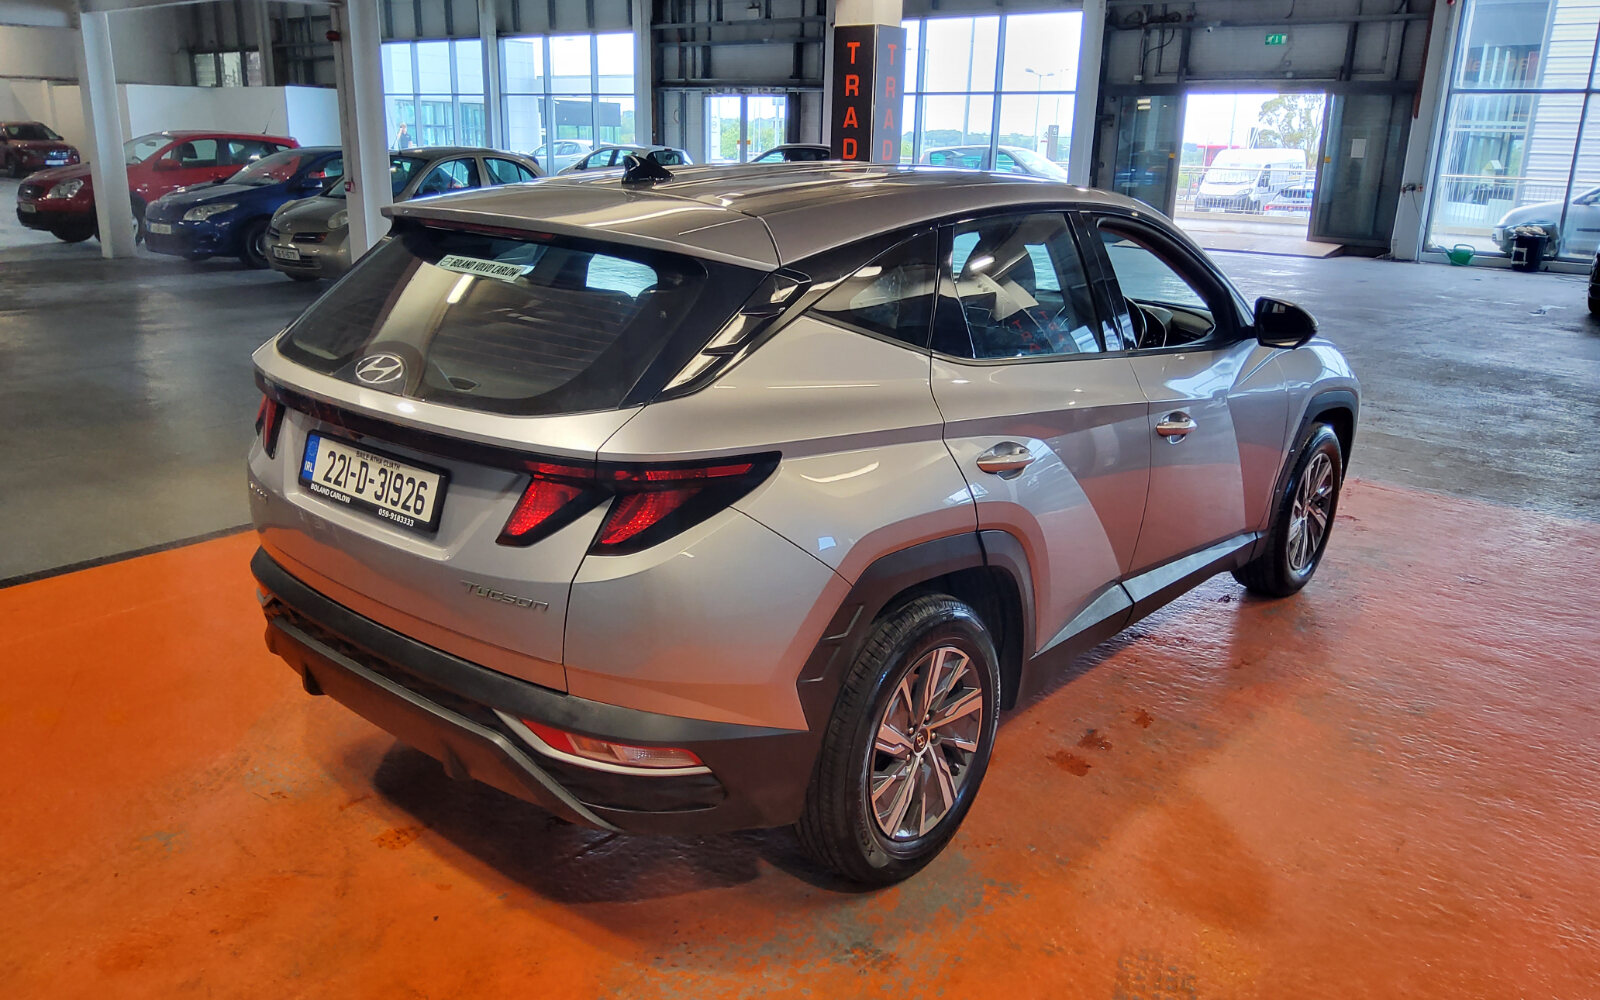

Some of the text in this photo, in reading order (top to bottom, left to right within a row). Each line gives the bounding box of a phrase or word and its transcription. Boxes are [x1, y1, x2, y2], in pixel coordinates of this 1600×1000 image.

[450, 259, 521, 277] BOLAND VOLVO CARLOW
[303, 460, 314, 473] IRL
[310, 482, 351, 504] BOLAND CARLOW
[323, 450, 428, 516] 221-D-31926
